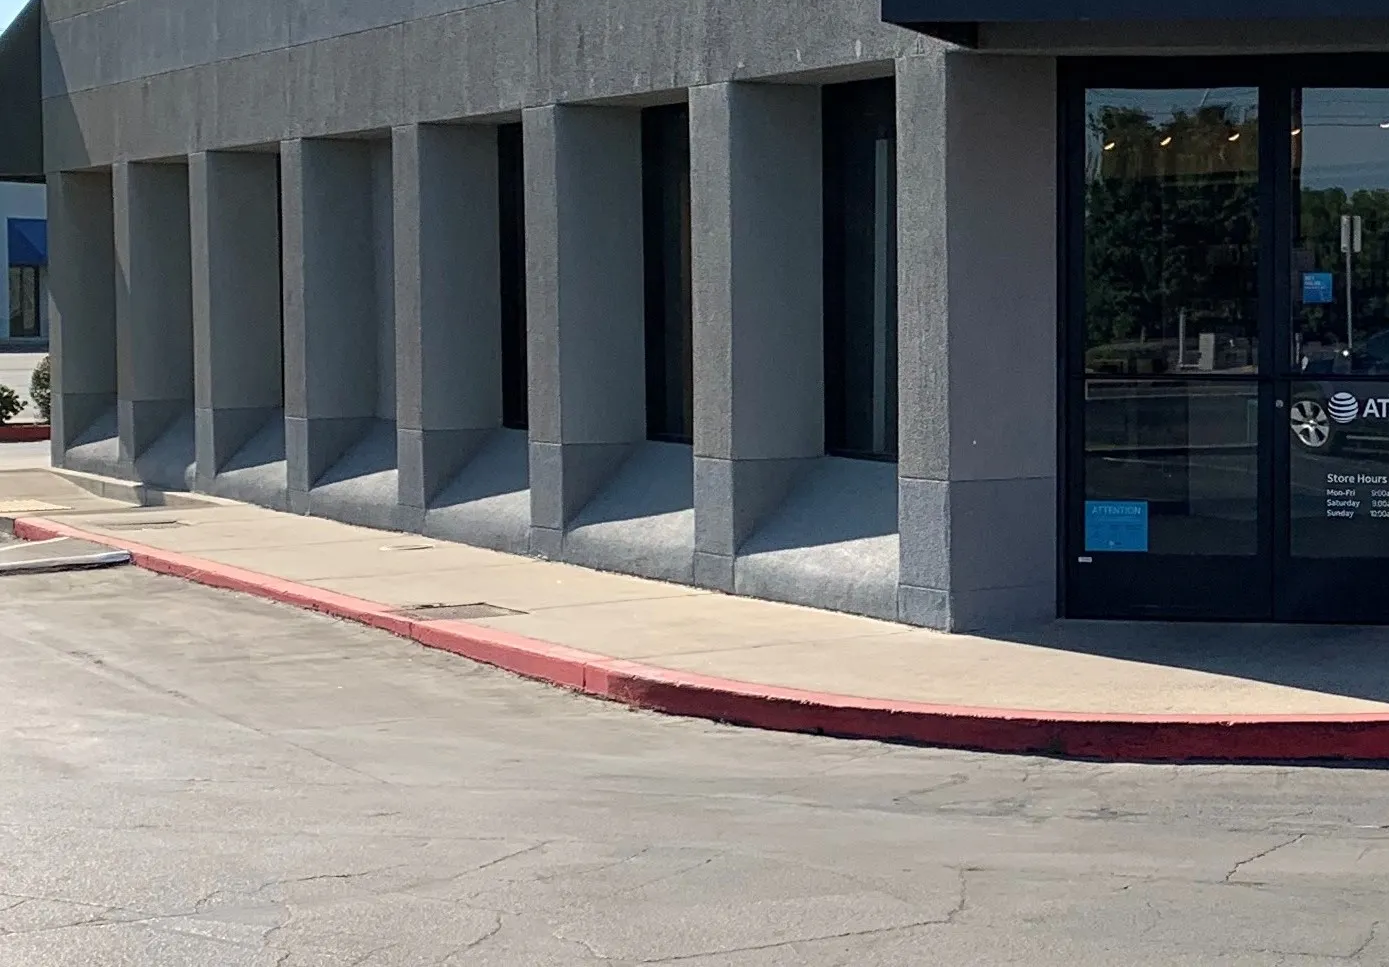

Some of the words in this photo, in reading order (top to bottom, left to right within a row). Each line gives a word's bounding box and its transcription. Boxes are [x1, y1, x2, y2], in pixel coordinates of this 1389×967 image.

[1327, 473, 1355, 483] Store
[1357, 474, 1388, 484] Hours
[1326, 489, 1356, 497] Mon-Fri
[1326, 499, 1360, 508] Saturday
[1092, 505, 1142, 515] ATTENTION
[1326, 509, 1355, 519] Sunday
